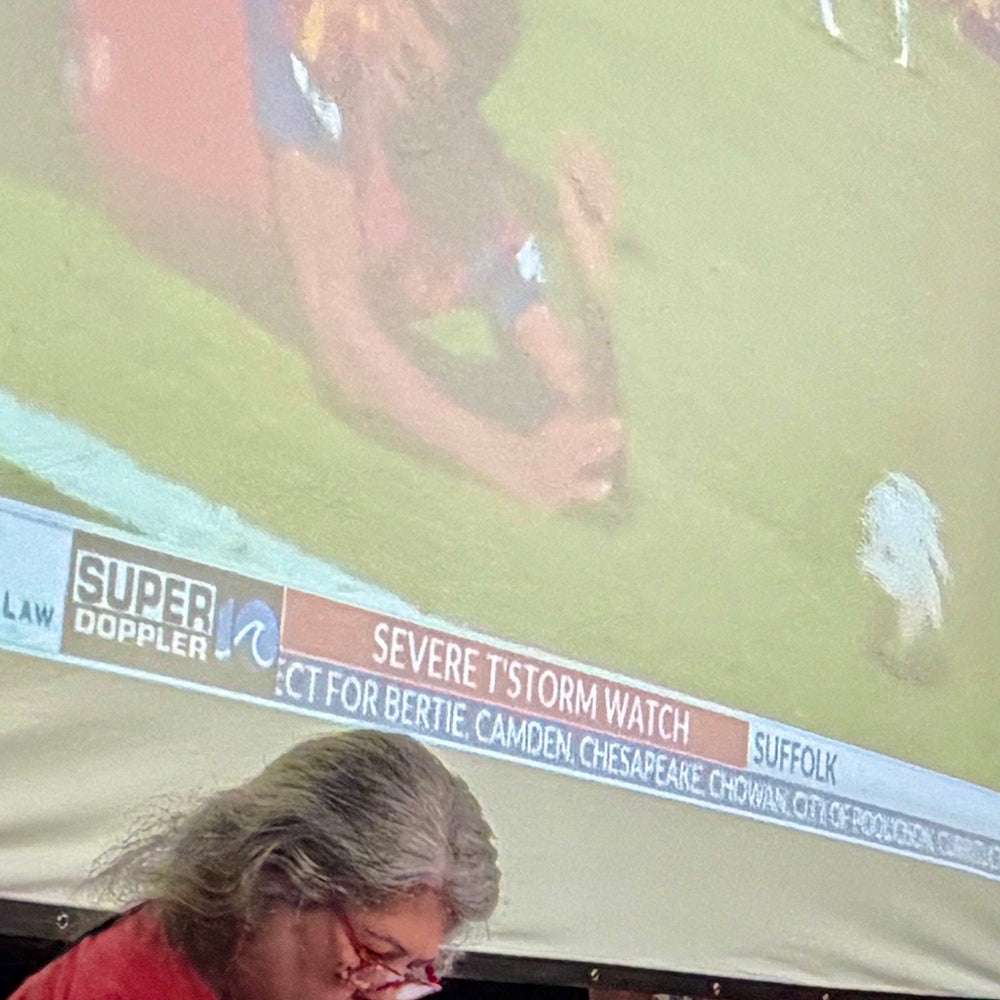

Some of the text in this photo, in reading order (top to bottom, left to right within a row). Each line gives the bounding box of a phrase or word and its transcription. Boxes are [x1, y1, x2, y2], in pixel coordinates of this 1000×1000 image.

[75, 550, 216, 634] SUPER
[74, 607, 207, 662] DOPPLER
[326, 670, 378, 717] FOR
[372, 622, 691, 744] SEVERE T'STORM WATCH
[752, 731, 837, 786] SUFFOLK
